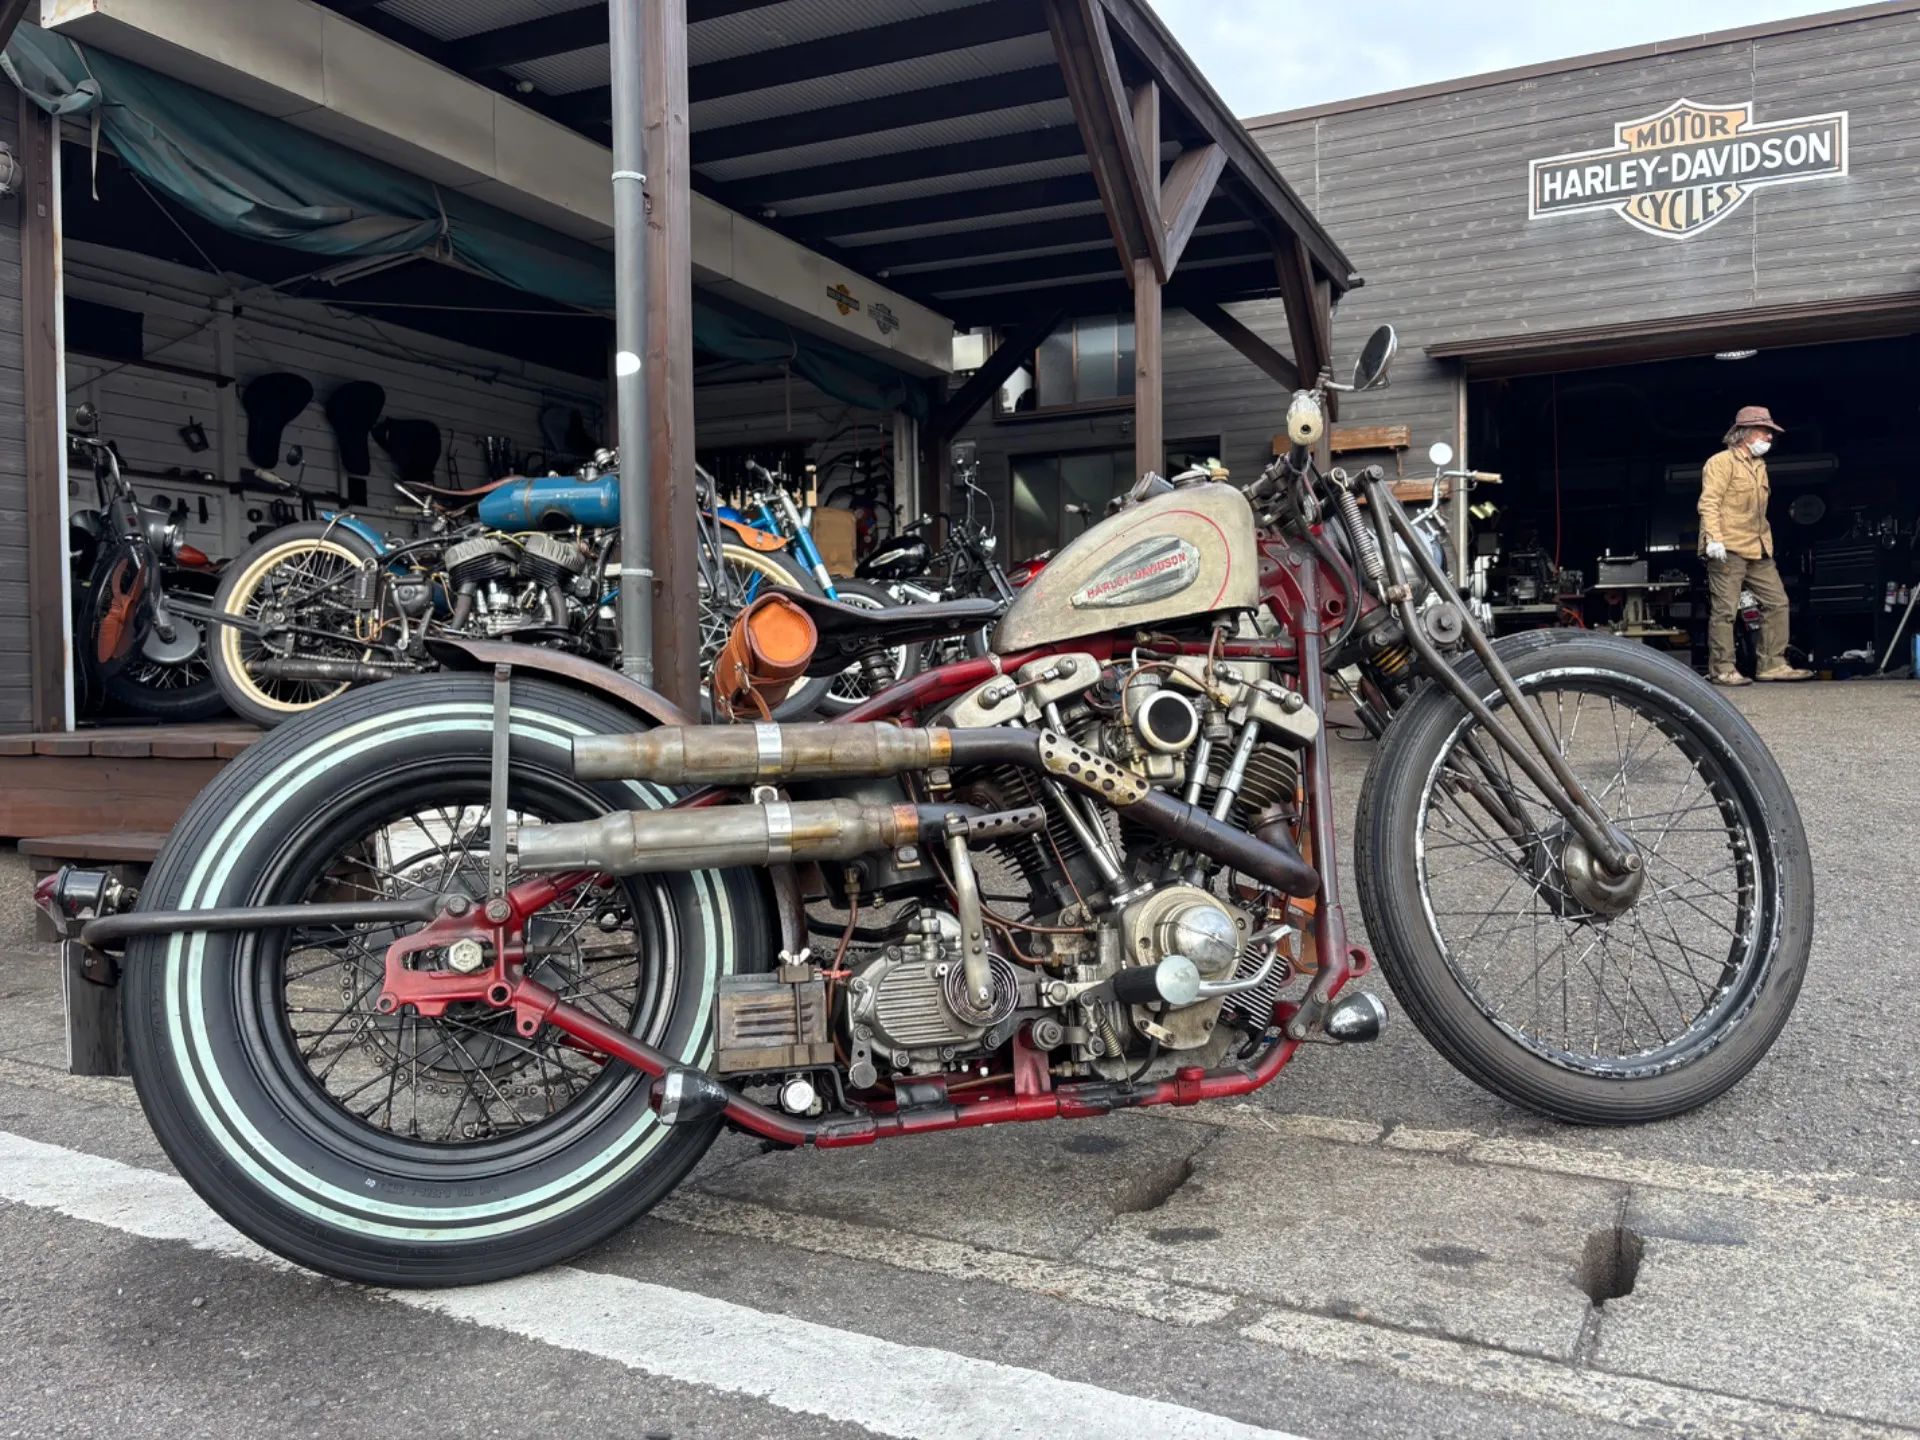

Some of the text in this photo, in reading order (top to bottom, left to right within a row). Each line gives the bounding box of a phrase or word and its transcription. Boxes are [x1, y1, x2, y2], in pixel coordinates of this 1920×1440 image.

[1636, 109, 1730, 148] MOTOR
[1544, 130, 1831, 202] HARLEY-DAVIDSON
[1637, 183, 1734, 229] CYCLES
